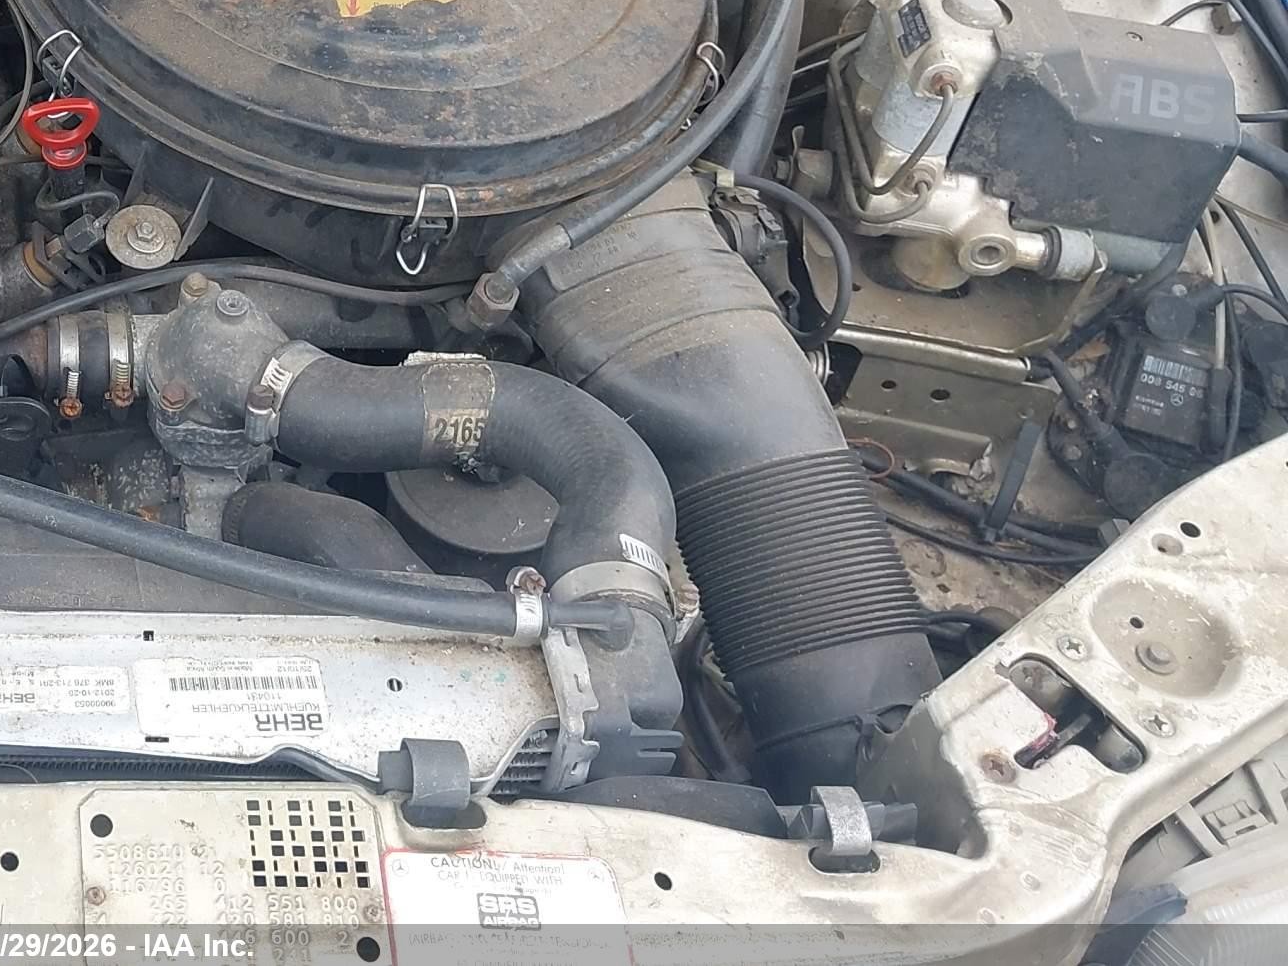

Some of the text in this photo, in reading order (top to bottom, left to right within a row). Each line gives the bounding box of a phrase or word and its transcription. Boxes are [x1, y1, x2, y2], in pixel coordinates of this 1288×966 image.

[1109, 73, 1216, 124] ABS
[1165, 380, 1186, 393] 545
[434, 418, 486, 443] 2165
[192, 702, 320, 712] KUEHLMITTELKUEHLER
[254, 713, 323, 731] BEHR
[512, 861, 565, 874] Attention!
[267, 894, 307, 912] 551
[321, 897, 358, 913] 800
[478, 895, 538, 916] SRS
[269, 913, 308, 929] 581
[322, 913, 360, 930] 810
[271, 930, 311, 946] 600
[336, 932, 348, 946] 2
